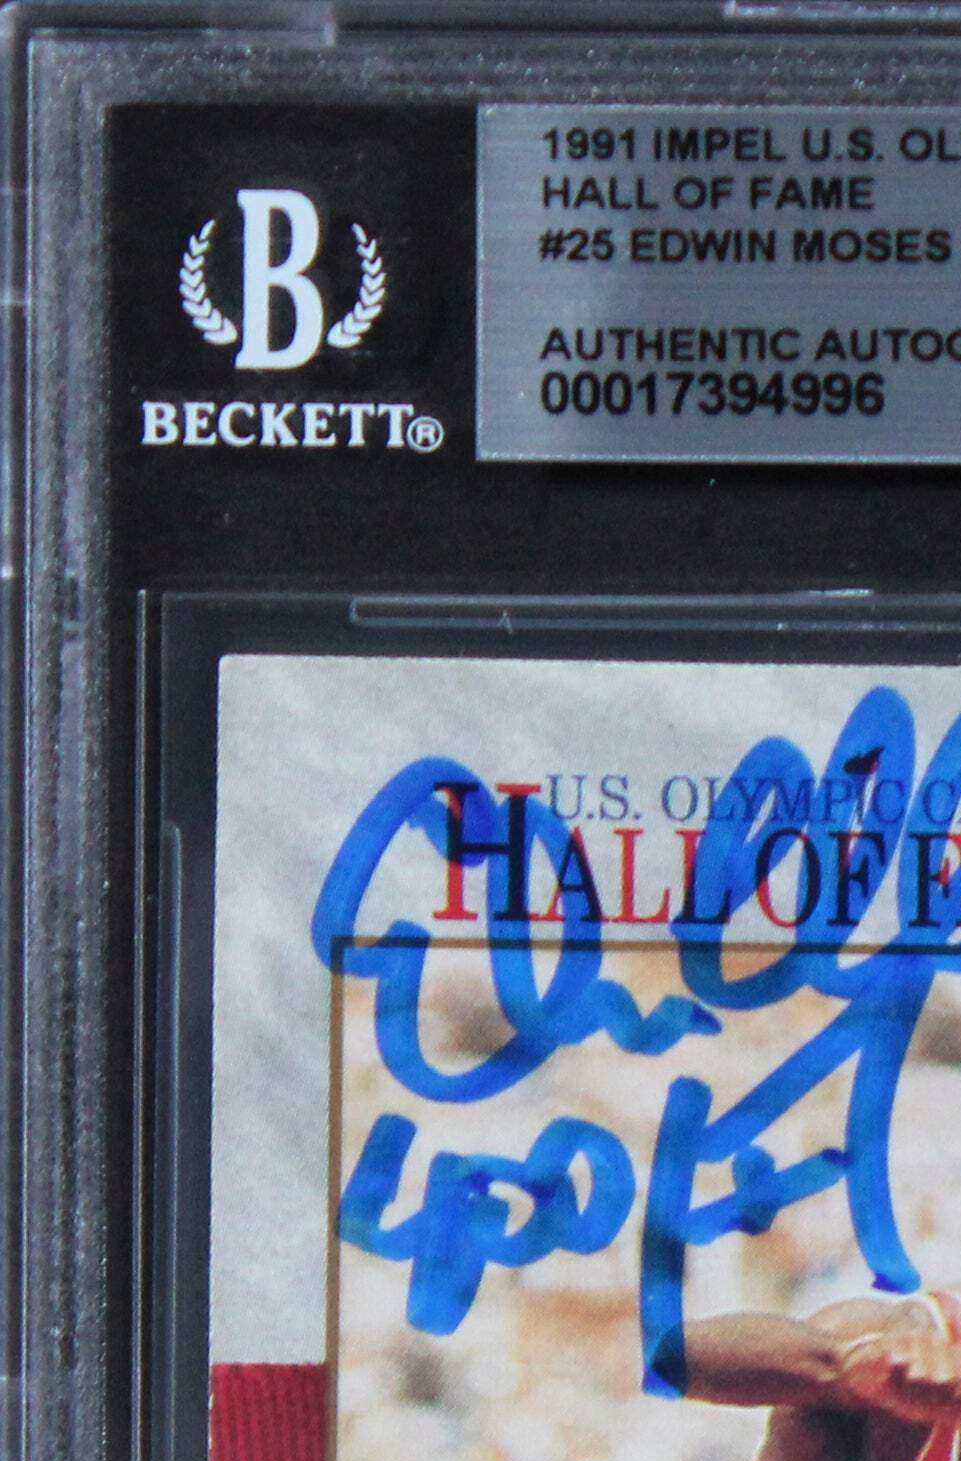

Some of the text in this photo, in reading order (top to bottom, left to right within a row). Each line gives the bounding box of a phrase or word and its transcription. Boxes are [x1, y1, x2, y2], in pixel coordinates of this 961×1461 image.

[542, 128, 636, 161] 1991
[652, 128, 786, 161] IMPEL
[802, 128, 884, 161] U.S.
[542, 177, 874, 210] HALL OF FAME
[538, 228, 952, 263] #25 EDWIN MOSES
[539, 329, 800, 362] AUTHENTIC
[540, 373, 886, 416] 00017394996
[546, 773, 641, 821] U.S.
[660, 773, 907, 825] OLYMPIC
[431, 781, 731, 924] HALL
[755, 828, 886, 928] OF
